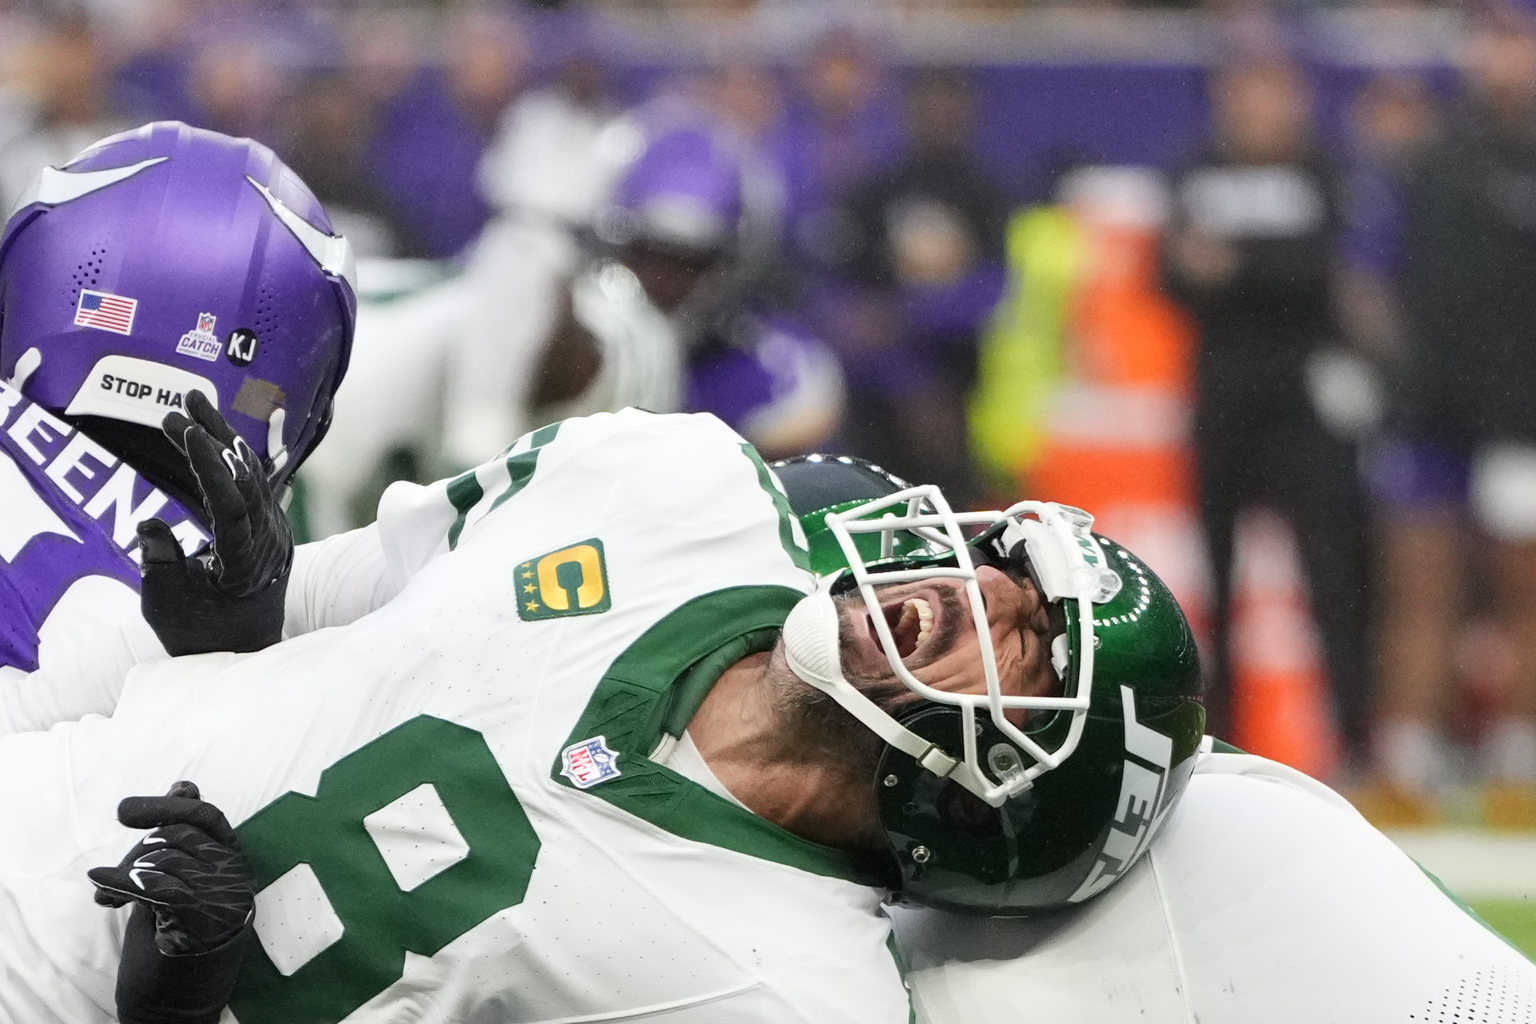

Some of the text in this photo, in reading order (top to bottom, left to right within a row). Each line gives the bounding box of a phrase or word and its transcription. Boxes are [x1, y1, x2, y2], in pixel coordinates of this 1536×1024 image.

[181, 337, 220, 356] CATCH
[227, 332, 256, 361] KJ
[101, 374, 186, 410] STOP HA
[537, 545, 604, 610] C
[570, 748, 595, 781] NFL
